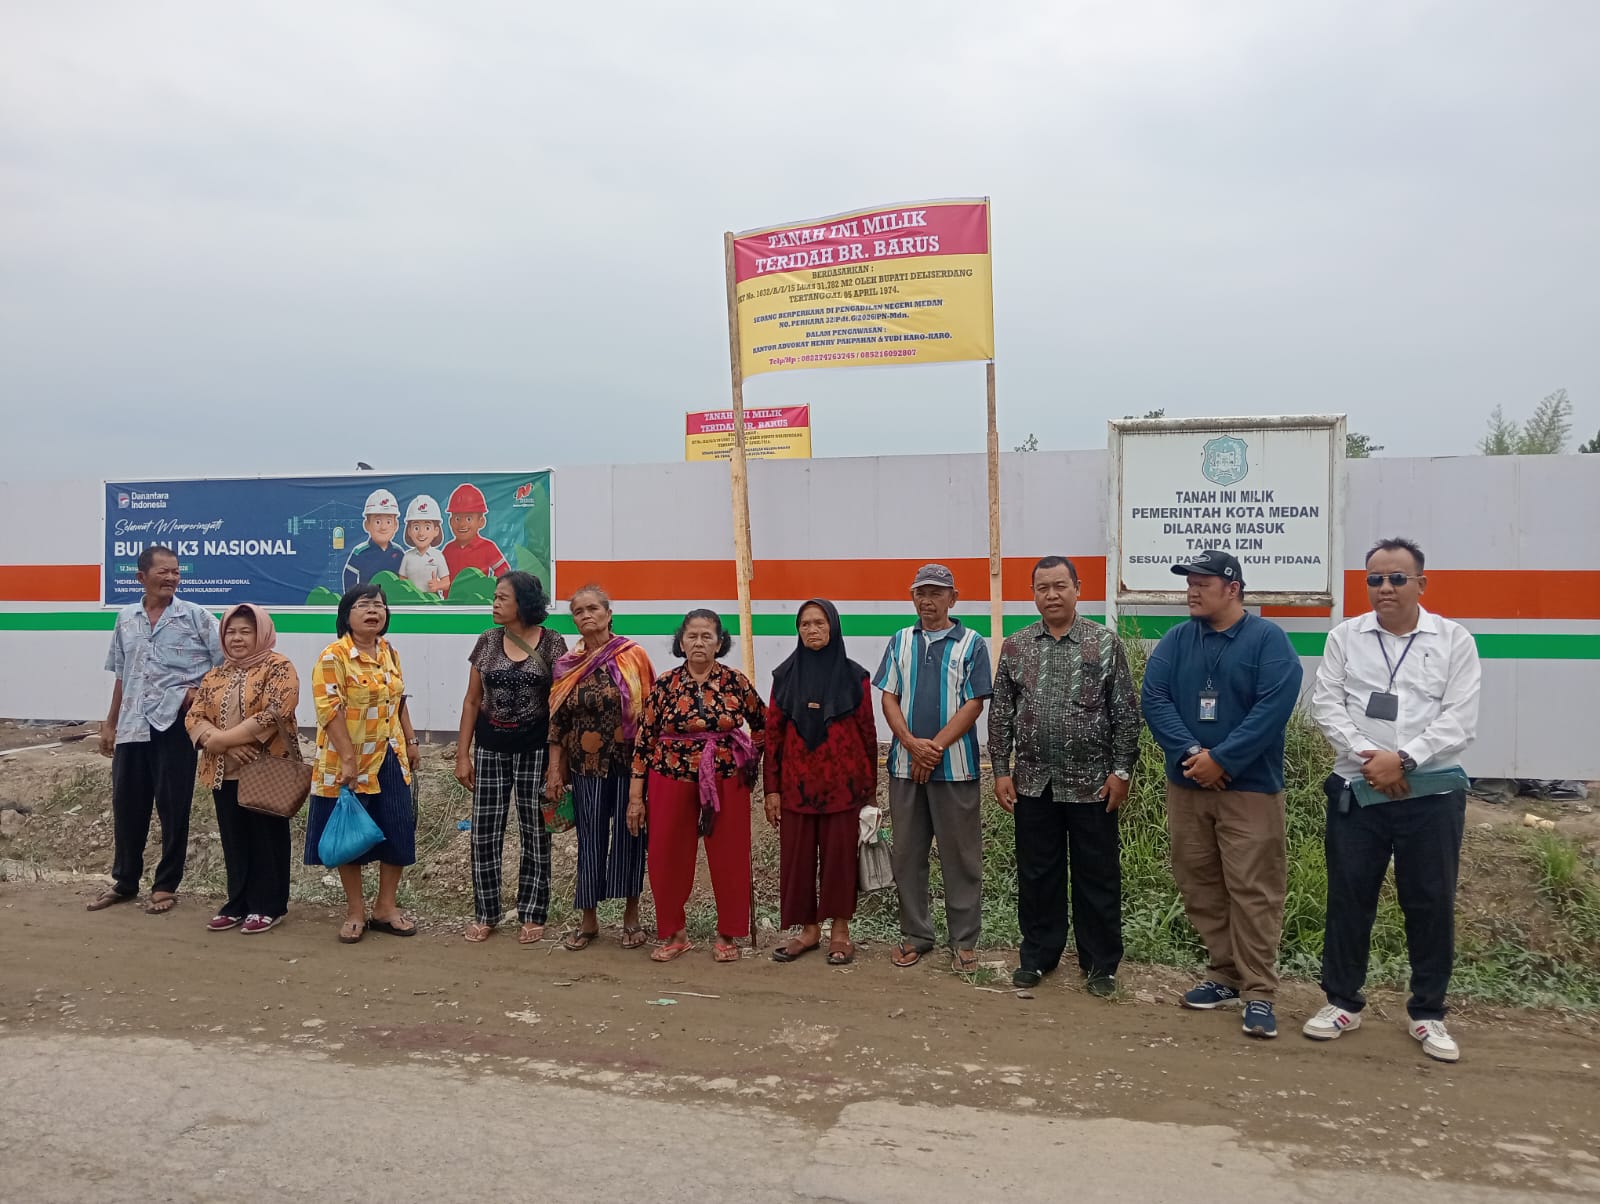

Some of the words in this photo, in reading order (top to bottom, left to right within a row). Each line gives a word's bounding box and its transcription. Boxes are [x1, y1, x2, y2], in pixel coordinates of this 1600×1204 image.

[768, 227, 827, 249] TANAH
[829, 221, 859, 239] INI
[862, 210, 927, 235] MILIK
[755, 247, 834, 274] TERIDAH
[838, 243, 869, 262] BR.
[873, 235, 940, 257] BARUS
[812, 264, 869, 279] BERDASARKAN
[841, 278, 853, 288] M2
[854, 276, 876, 286] OLEH
[878, 272, 909, 284] BUPATI
[910, 269, 973, 280] DELISERDANG
[789, 291, 842, 303] TERTANGGAL
[854, 288, 878, 298] APRIL
[880, 286, 900, 296] 1974.
[754, 313, 777, 324] SEDANG
[778, 308, 824, 319] BERPERKARA
[836, 304, 882, 313] PENGADILAN
[884, 301, 912, 310] NEGERI
[914, 299, 943, 307] MEDAN
[792, 318, 824, 327] PERKARA
[806, 330, 831, 338] DALAM
[832, 326, 882, 336] PENGAWASAN
[752, 344, 776, 354] KANTOR
[778, 341, 809, 350] ADVOKAT
[810, 338, 836, 347] HENRY
[836, 336, 876, 344] PAKPAHAN
[884, 334, 902, 342] YUDI
[704, 412, 733, 420] TANAH
[752, 409, 782, 418] MILIK
[700, 423, 735, 432] TERIDA
[758, 419, 788, 429] BARUS
[131, 492, 169, 500] Danantara
[1176, 491, 1216, 504] TANAH
[1220, 490, 1236, 503] INI
[1240, 490, 1274, 503] MILIK
[131, 500, 167, 509] Indonesia
[1132, 508, 1221, 518] PEMERINTAH
[1226, 506, 1264, 518] KOTA
[1269, 506, 1319, 518] MEDAN
[1163, 523, 1232, 534] DILARANG
[1236, 522, 1285, 534] MASUK
[178, 540, 198, 556] K3
[204, 540, 297, 556] NASIONAL
[1186, 538, 1231, 550] TANPA
[1236, 538, 1263, 550] IZIN
[1129, 556, 1172, 564] SESUAI
[1244, 556, 1270, 564] KUH
[1274, 556, 1321, 564] PIDANA
